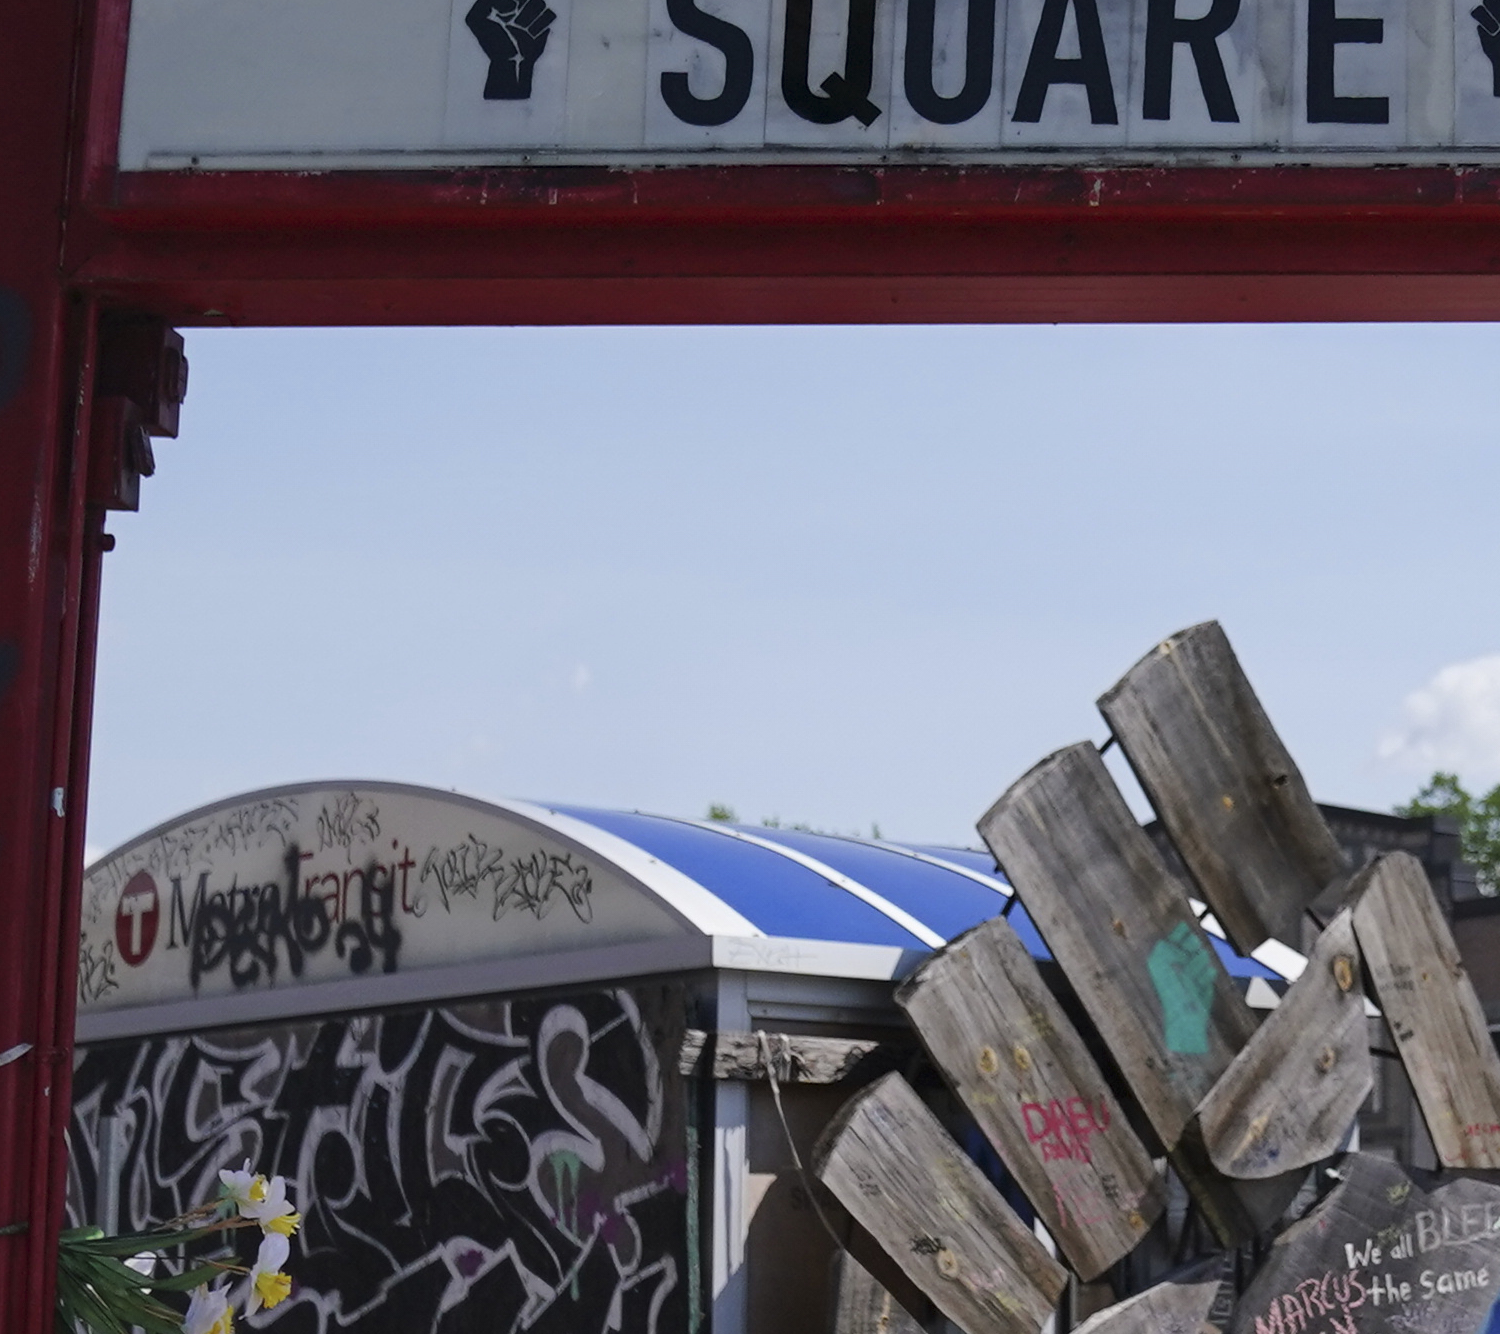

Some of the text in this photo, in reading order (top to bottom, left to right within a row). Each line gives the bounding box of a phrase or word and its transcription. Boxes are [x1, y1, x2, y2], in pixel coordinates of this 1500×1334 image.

[1344, 1233, 1414, 1269] We all
[1366, 1267, 1491, 1307] the Same
